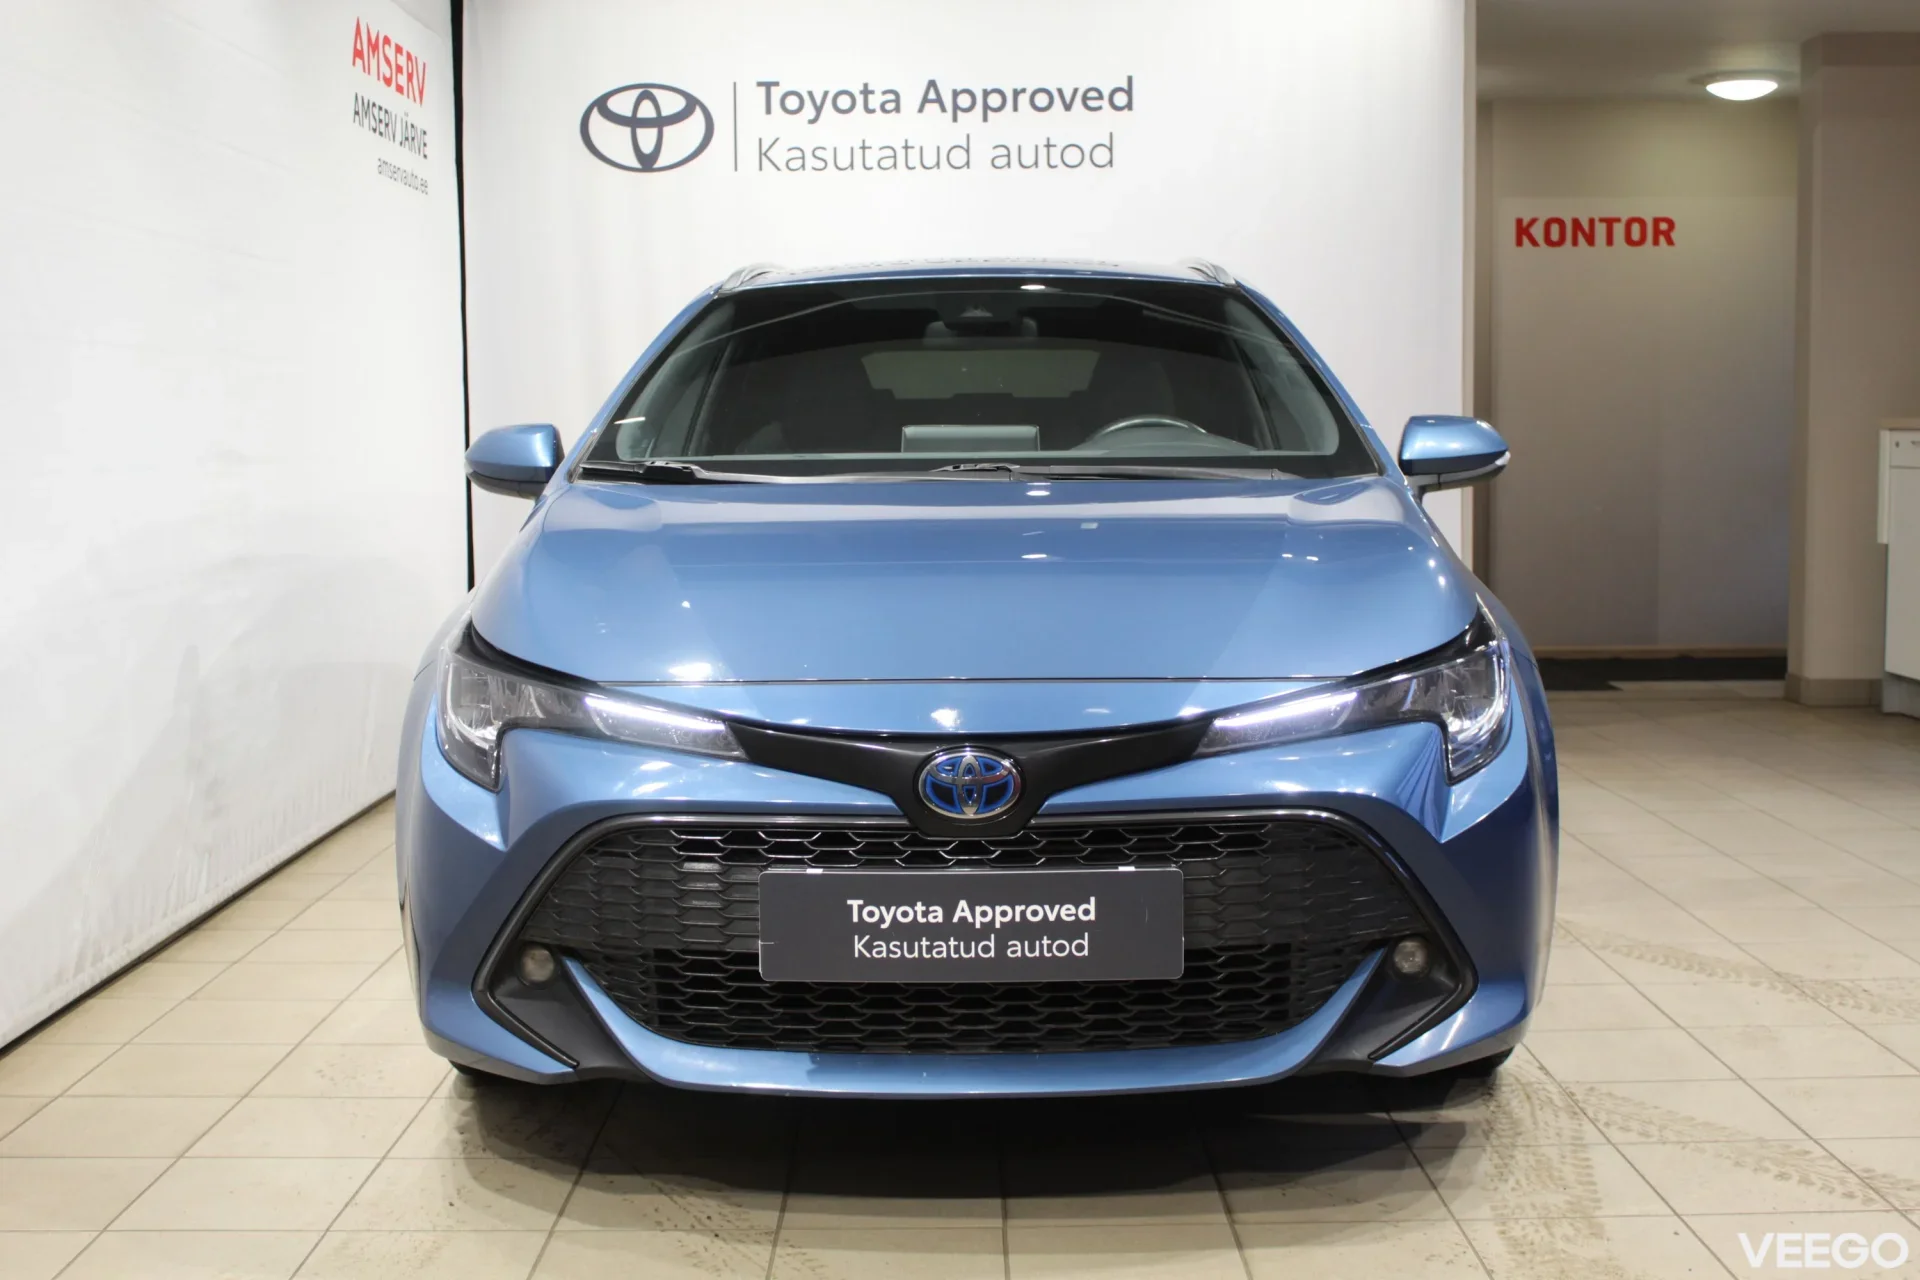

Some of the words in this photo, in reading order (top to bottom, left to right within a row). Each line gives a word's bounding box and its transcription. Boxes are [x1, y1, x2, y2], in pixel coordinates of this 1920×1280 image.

[352, 16, 427, 107] AMSERV
[756, 80, 902, 124] Toyota
[917, 75, 1135, 122] Approved
[353, 92, 397, 143] AMSERV
[399, 112, 428, 160] JÄRVE
[757, 133, 971, 172] Kasutatud
[990, 132, 1115, 170] autod
[377, 157, 429, 196] amservauto.ee
[1515, 216, 1676, 248] KONTOR
[847, 899, 944, 928] Toyota
[952, 897, 1096, 929] Approved
[853, 934, 996, 959] Kasutatud
[1006, 932, 1089, 957] autod
